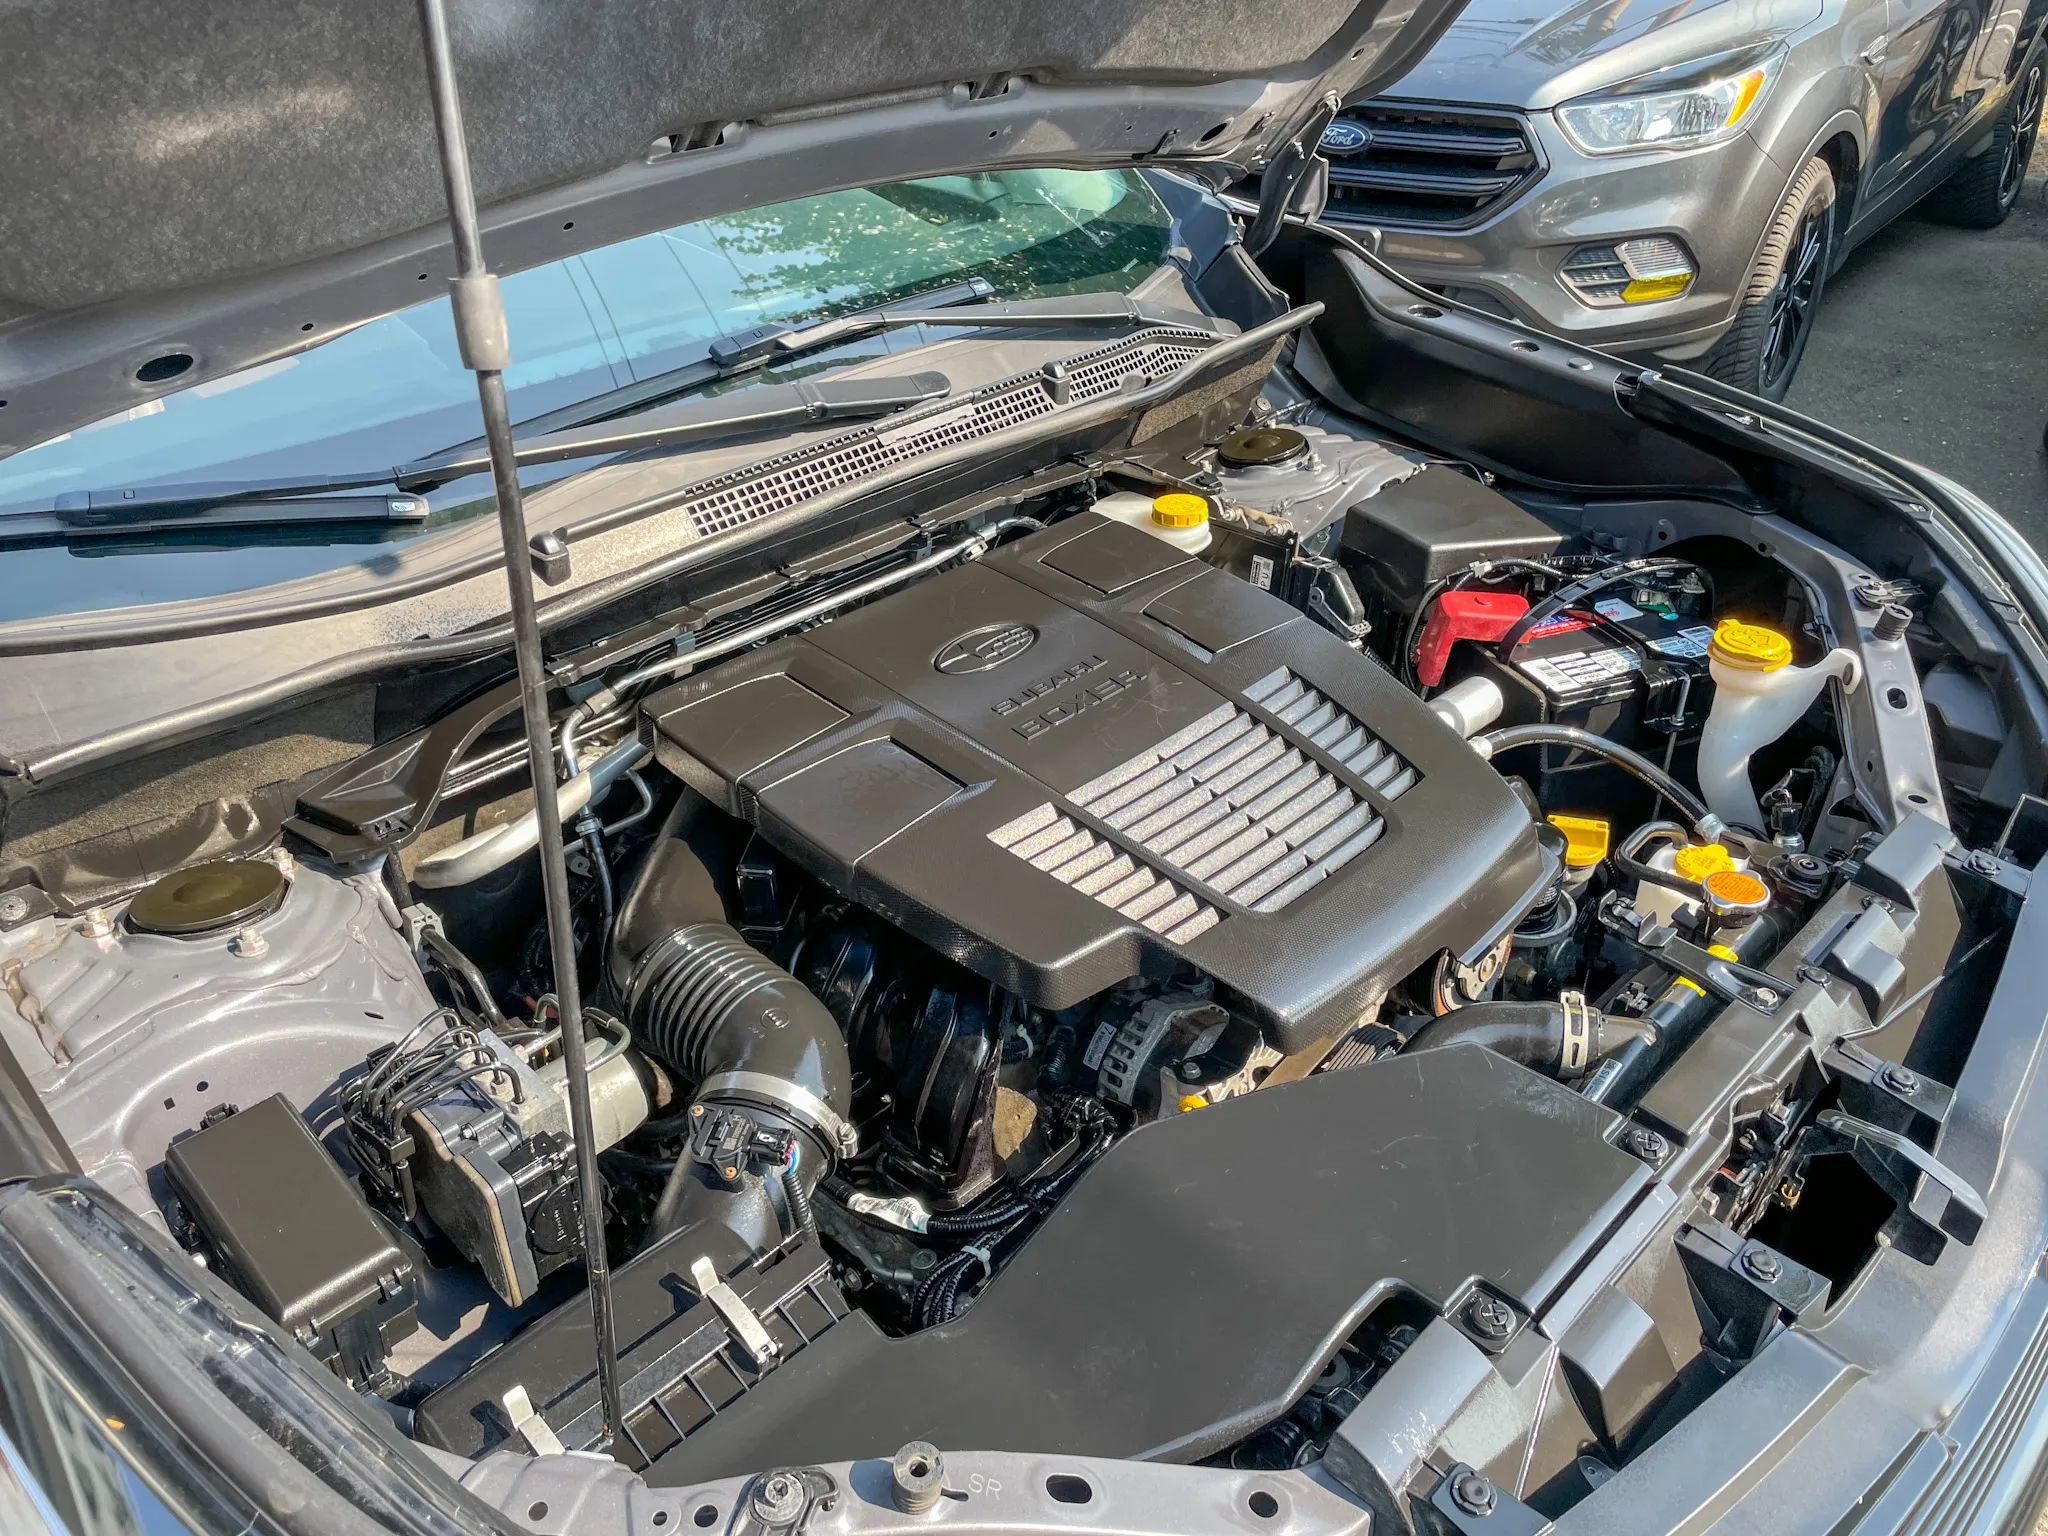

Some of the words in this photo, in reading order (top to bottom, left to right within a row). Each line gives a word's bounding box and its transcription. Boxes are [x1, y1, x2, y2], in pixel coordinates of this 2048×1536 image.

[1322, 127, 1354, 145] Ford
[990, 655, 1108, 715] SUBARU
[1011, 670, 1147, 740] BOXER
[968, 1472, 1002, 1500] SR
